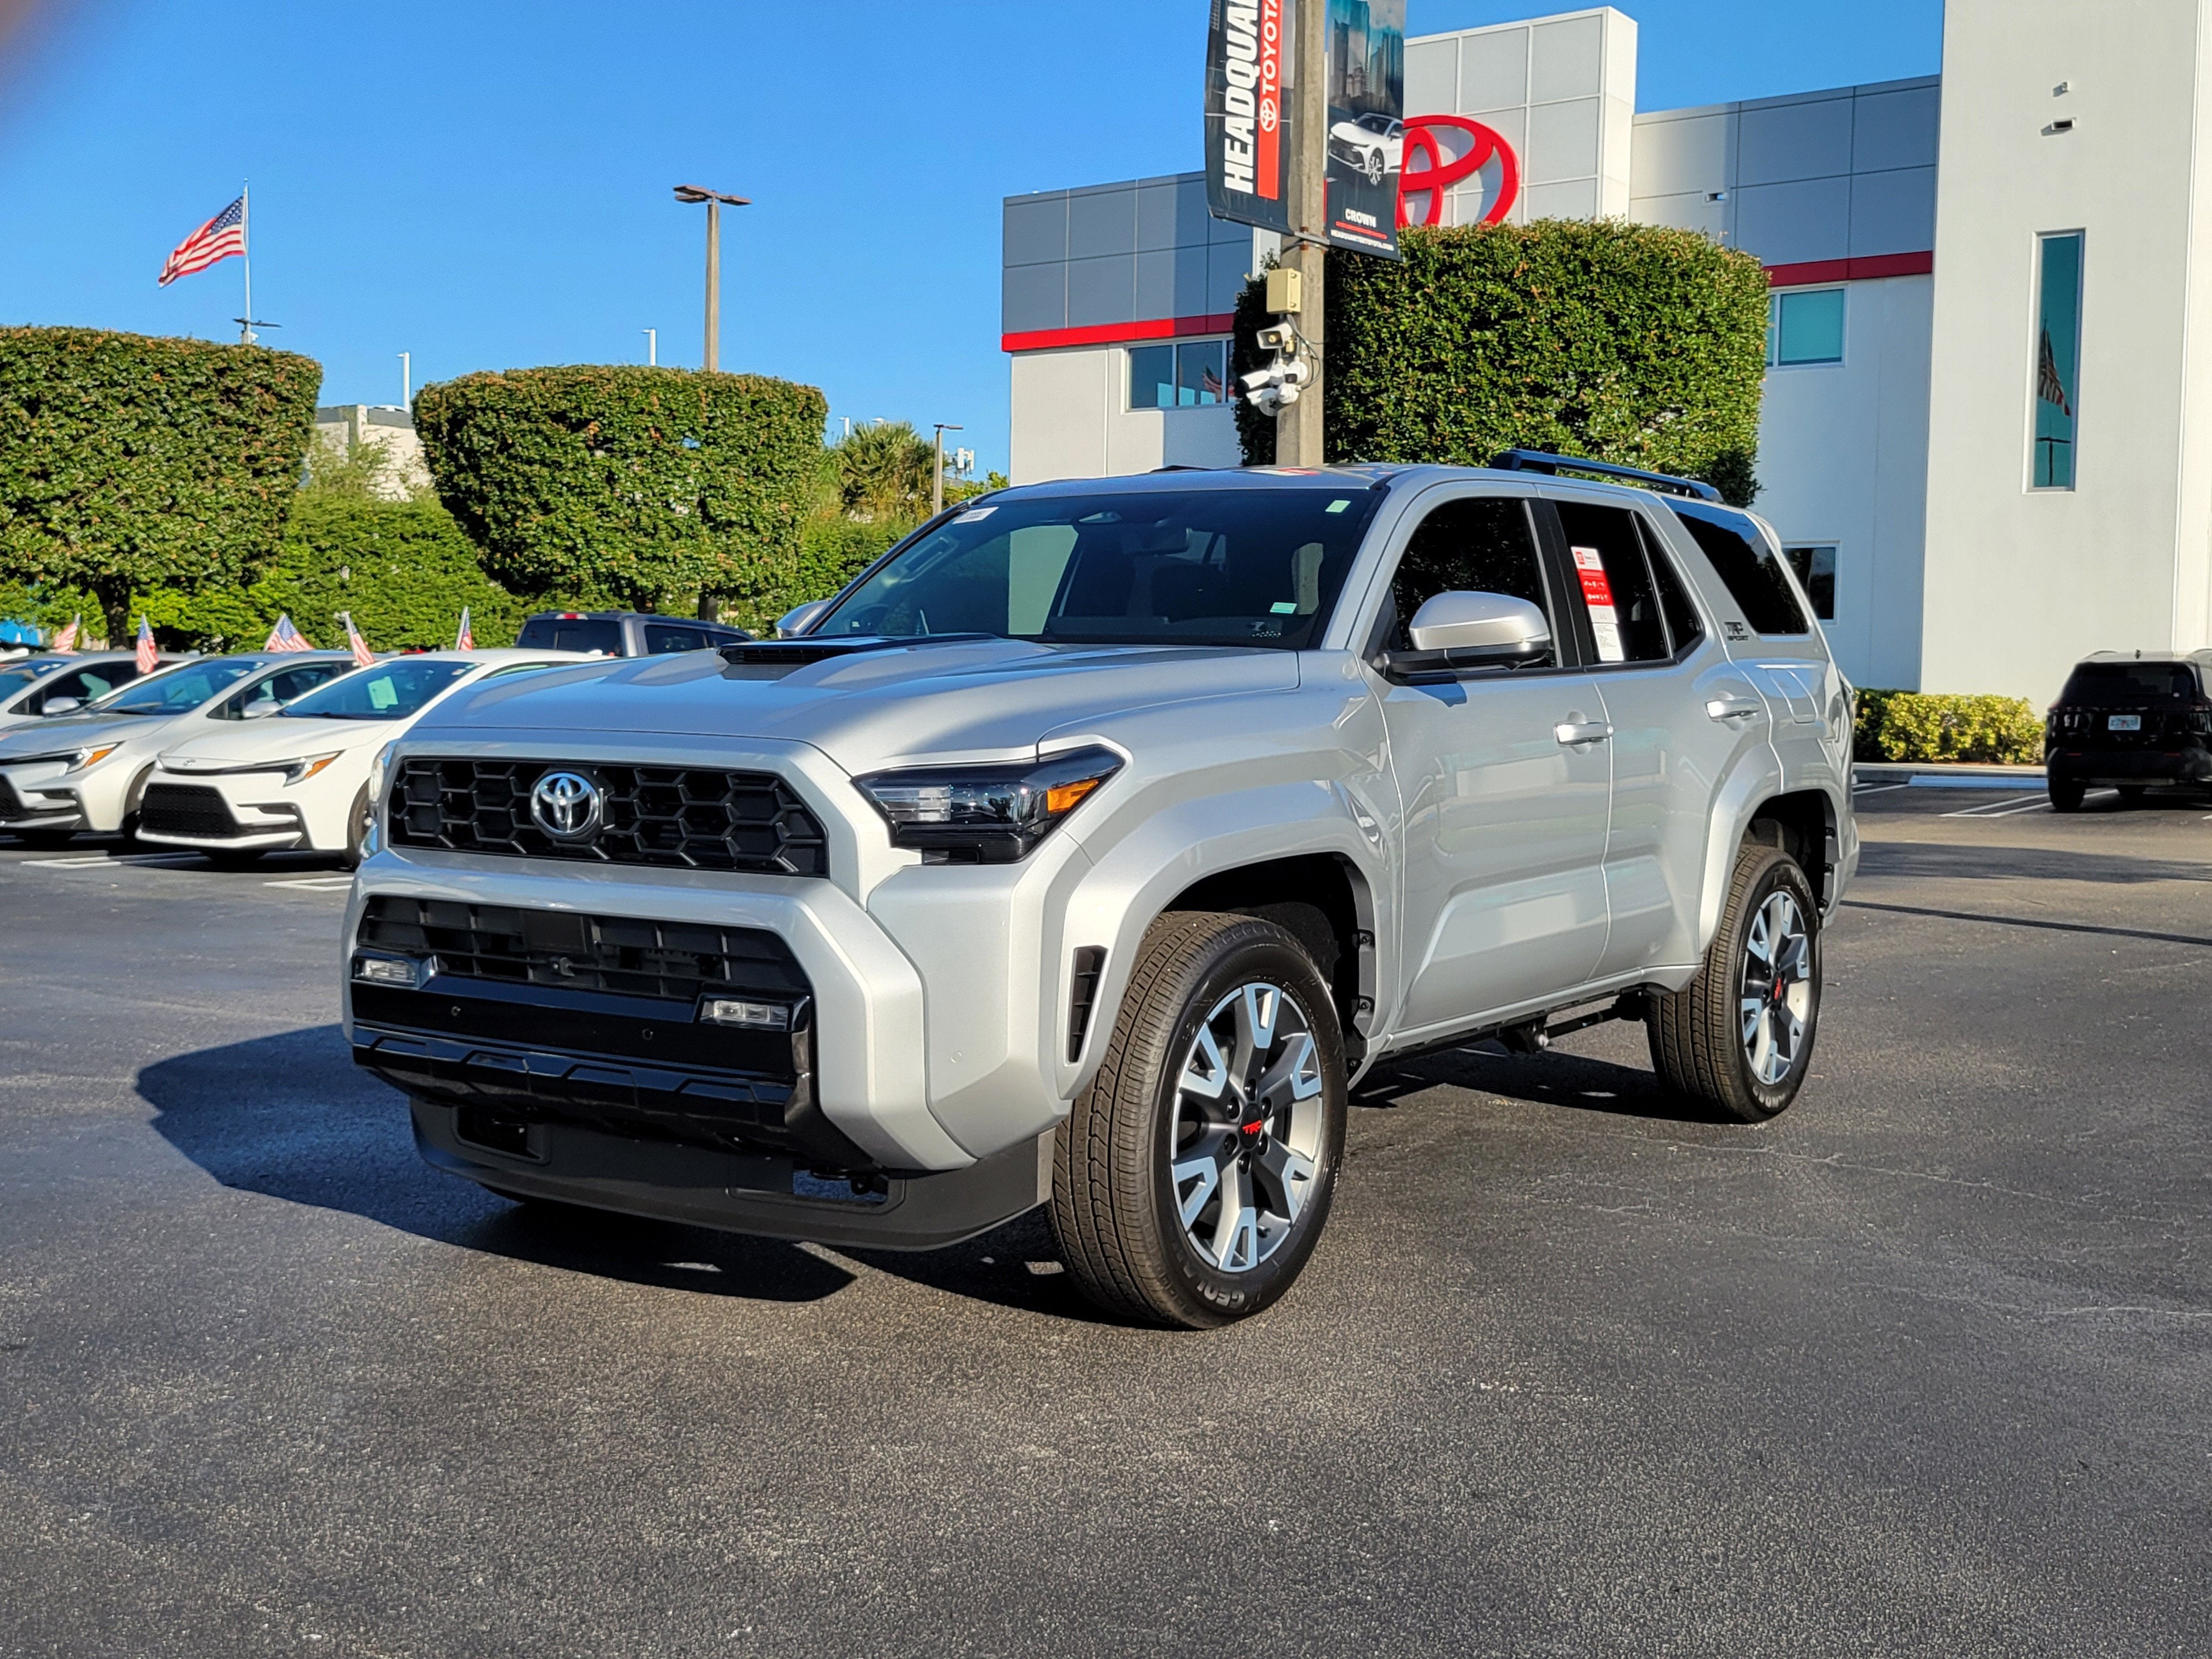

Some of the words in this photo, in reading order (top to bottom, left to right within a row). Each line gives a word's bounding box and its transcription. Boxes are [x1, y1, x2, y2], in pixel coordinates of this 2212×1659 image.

[1224, 0, 1261, 194] HEADQUA
[1345, 208, 1376, 228] CROWN
[1242, 1120, 1261, 1135] TRD
